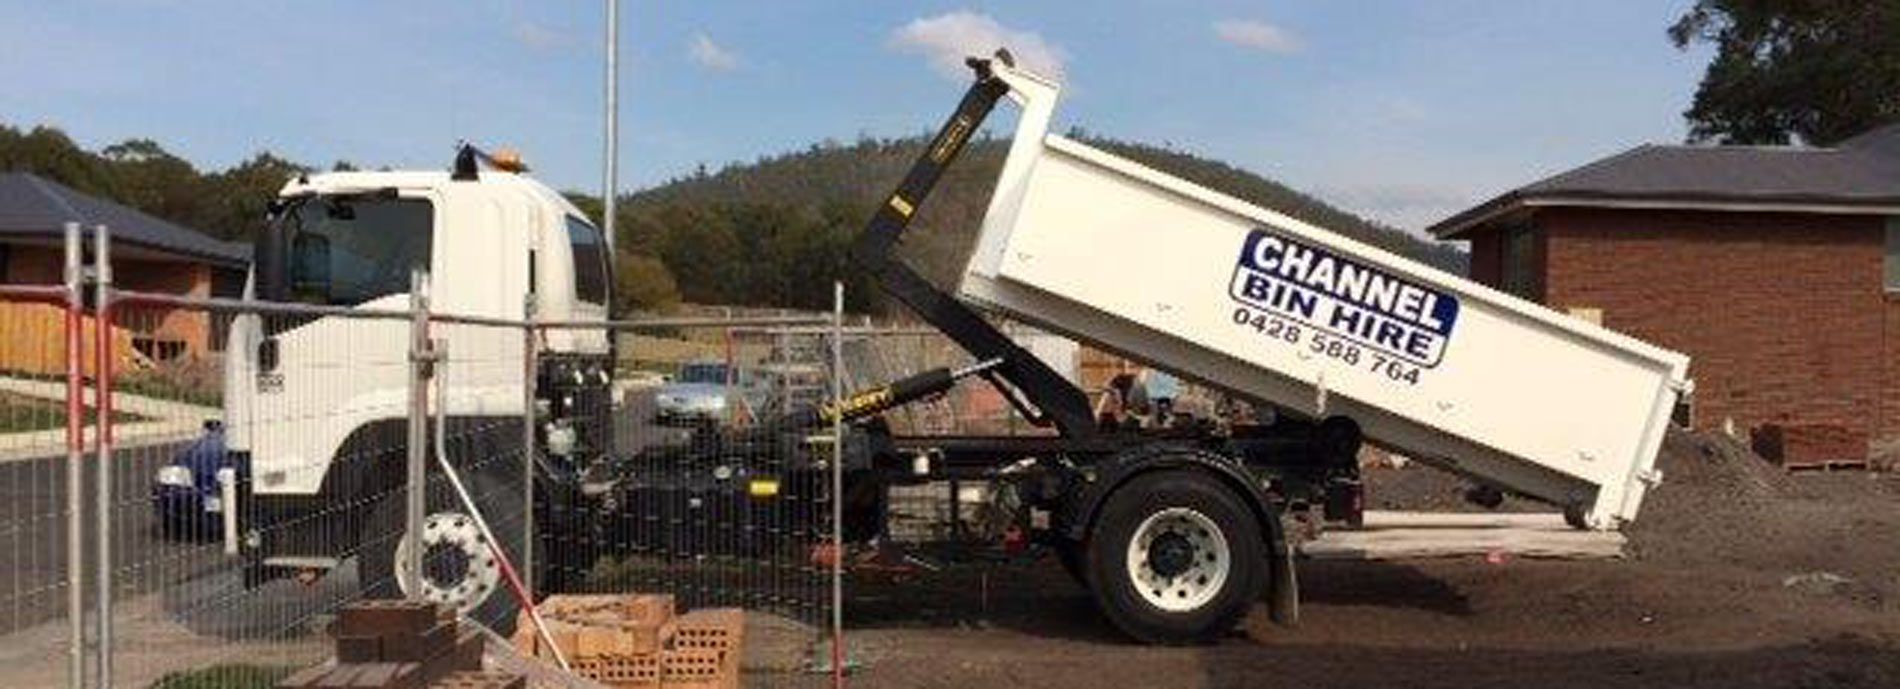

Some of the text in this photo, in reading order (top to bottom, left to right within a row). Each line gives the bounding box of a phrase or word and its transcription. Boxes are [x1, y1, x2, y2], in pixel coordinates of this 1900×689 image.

[1241, 272, 1433, 360] BIN HIRE
[1254, 236, 1443, 329] CHANNEL
[1233, 307, 1420, 386] 0428 588 764
